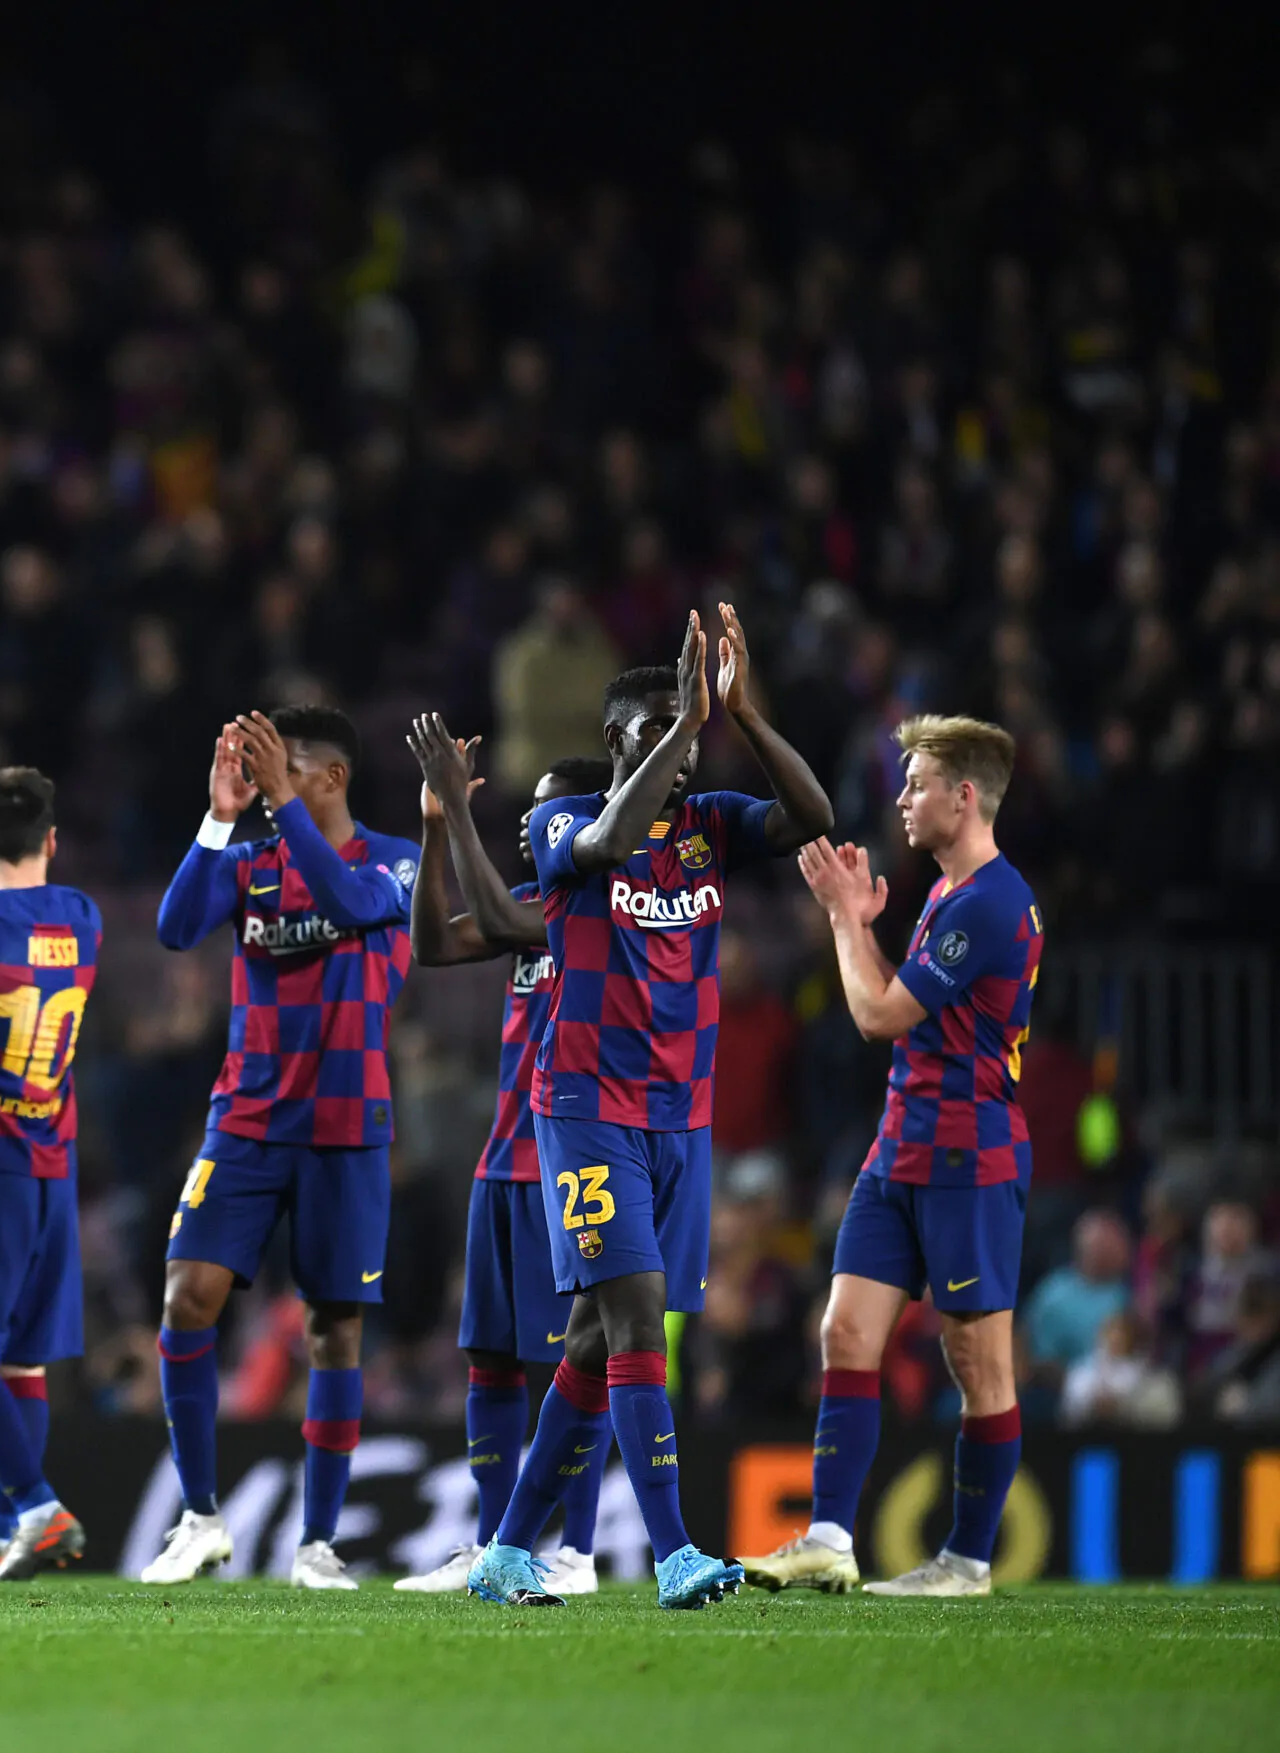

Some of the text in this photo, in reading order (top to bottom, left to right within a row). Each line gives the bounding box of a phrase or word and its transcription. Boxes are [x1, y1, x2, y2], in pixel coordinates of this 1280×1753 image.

[611, 880, 721, 921] Rakuten
[243, 915, 358, 947] Rakute
[28, 936, 79, 966] MESSI
[927, 960, 956, 987] RESPECT
[556, 1165, 616, 1231] 23
